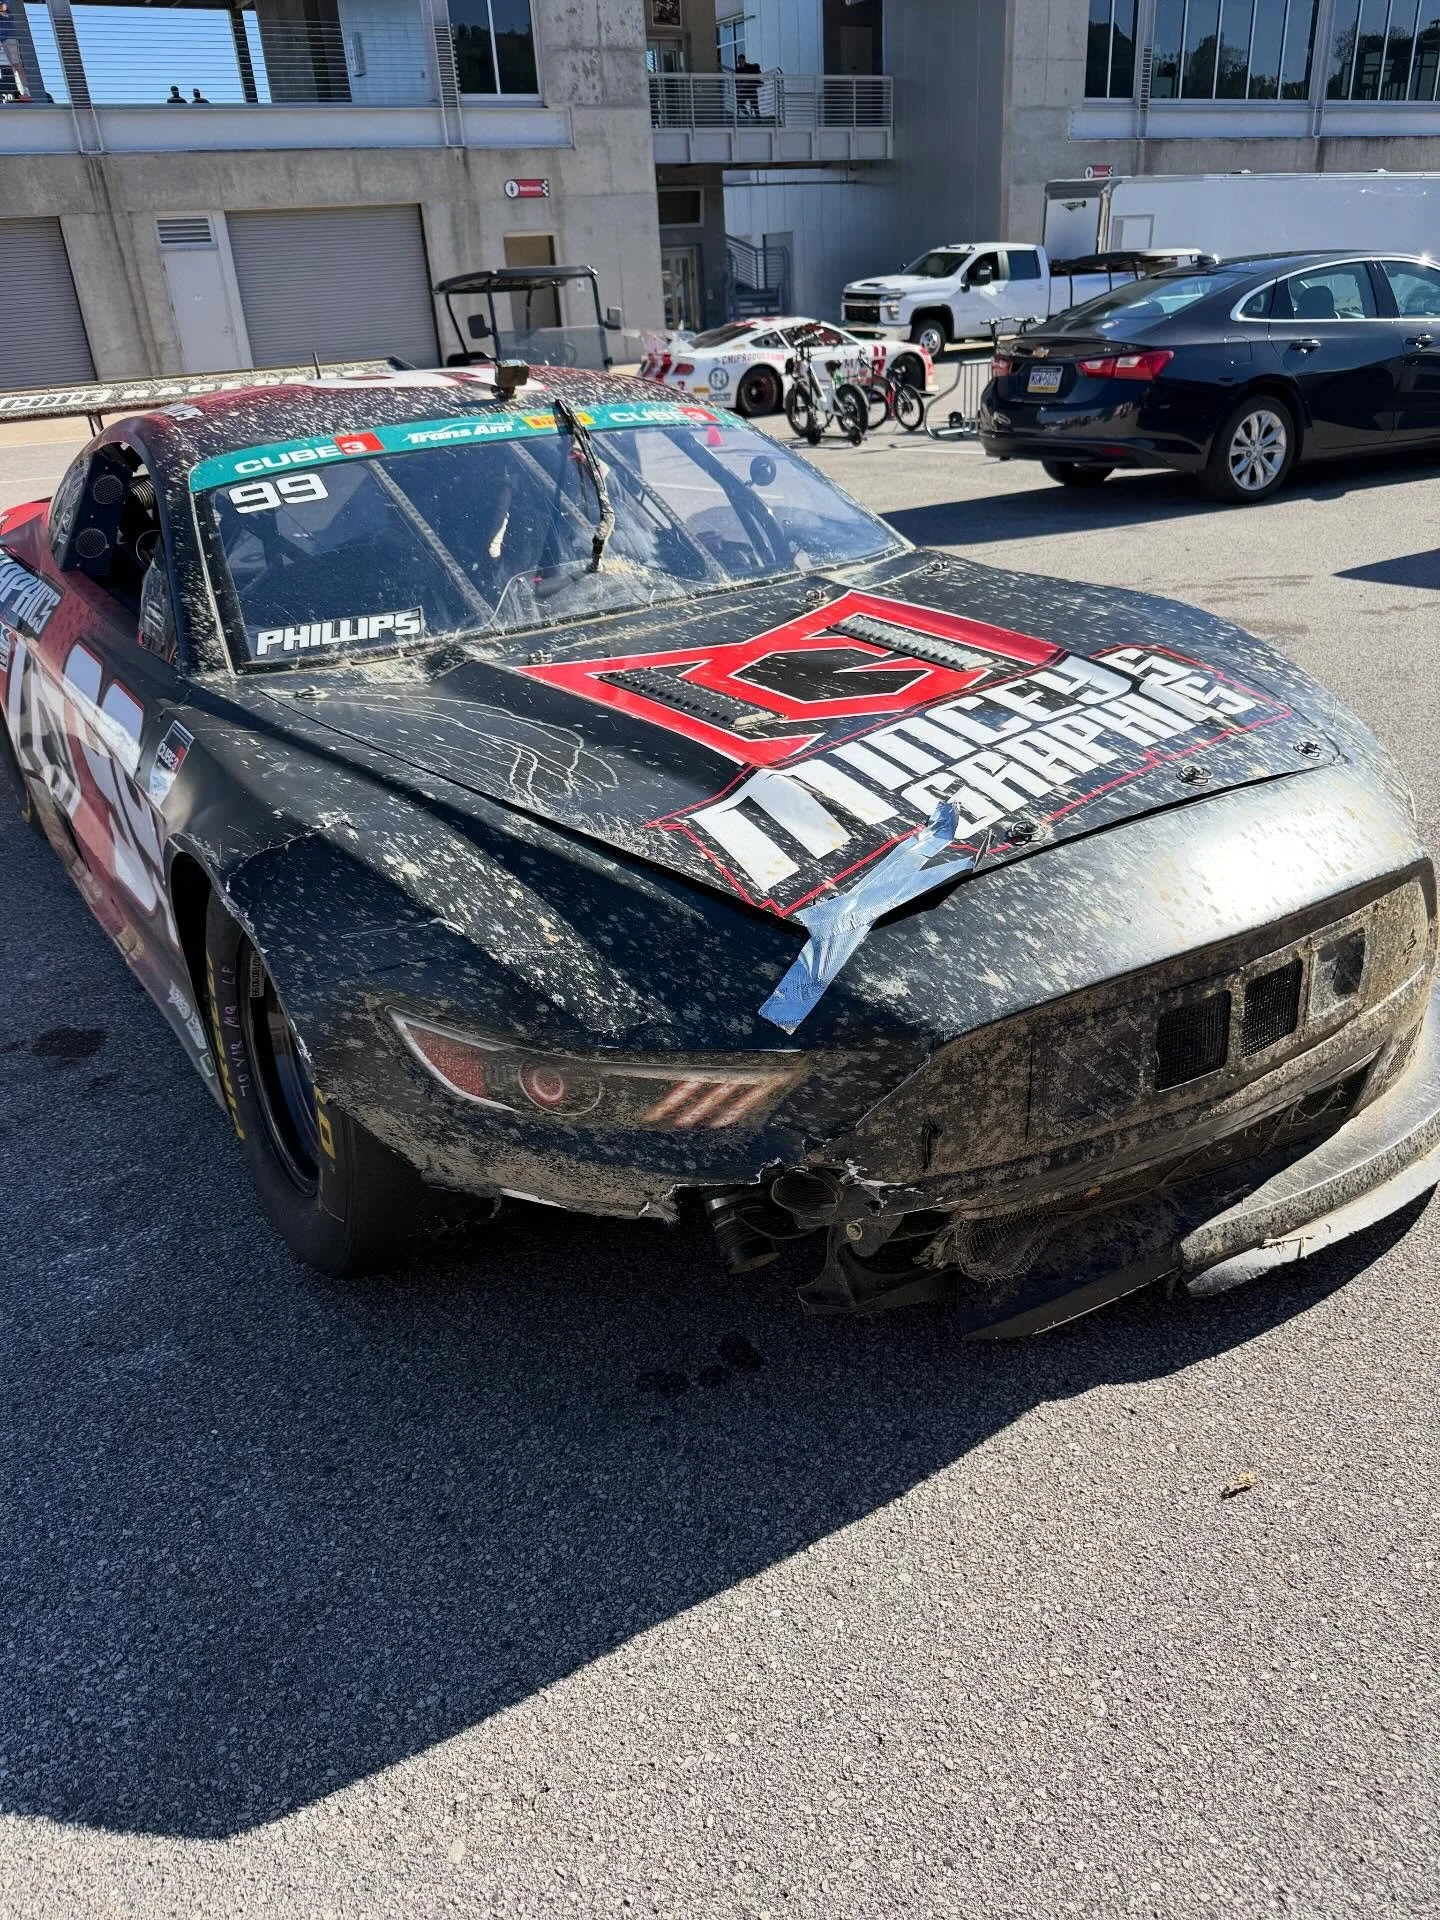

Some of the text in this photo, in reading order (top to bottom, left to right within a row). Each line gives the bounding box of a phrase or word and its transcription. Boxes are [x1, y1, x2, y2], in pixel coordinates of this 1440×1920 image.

[408, 421, 514, 444] Trans Am
[228, 473, 329, 514] 99
[256, 611, 421, 656] PHILLIPS
[901, 676, 1257, 840] GRAPHICS
